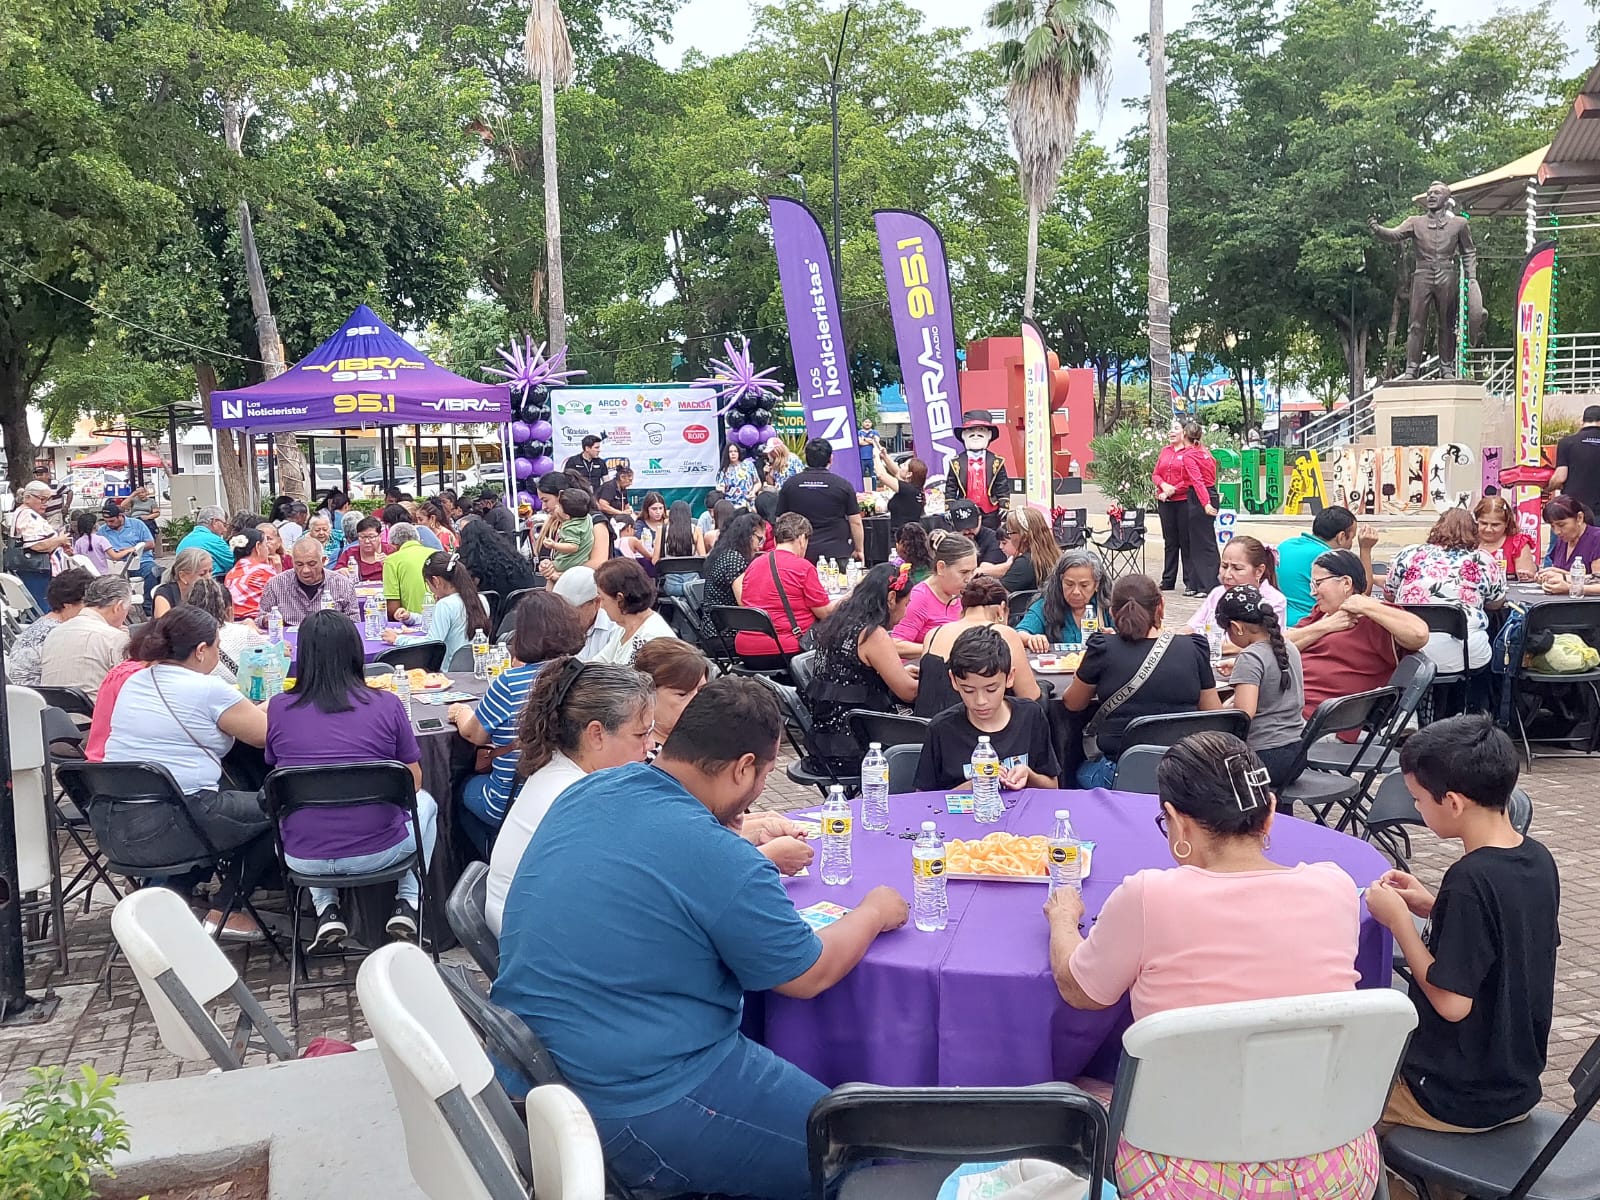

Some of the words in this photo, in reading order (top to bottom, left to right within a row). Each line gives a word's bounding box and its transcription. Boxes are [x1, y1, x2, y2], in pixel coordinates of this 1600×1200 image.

[897, 237, 934, 319] 95.1
[346, 326, 380, 337] 95.1
[804, 258, 842, 396] Noticieristas
[932, 326, 943, 360] RADIO
[302, 357, 425, 373] VIBRA
[331, 370, 397, 382] 95.1
[333, 393, 396, 413] 95.1
[421, 398, 500, 411] VIBRA
[917, 327, 957, 478] VIBRA
[1520, 304, 1534, 494] MACAS
[247, 406, 309, 417] Noticieristas
[687, 432, 705, 440] ROJO
[683, 465, 708, 473] JAS
